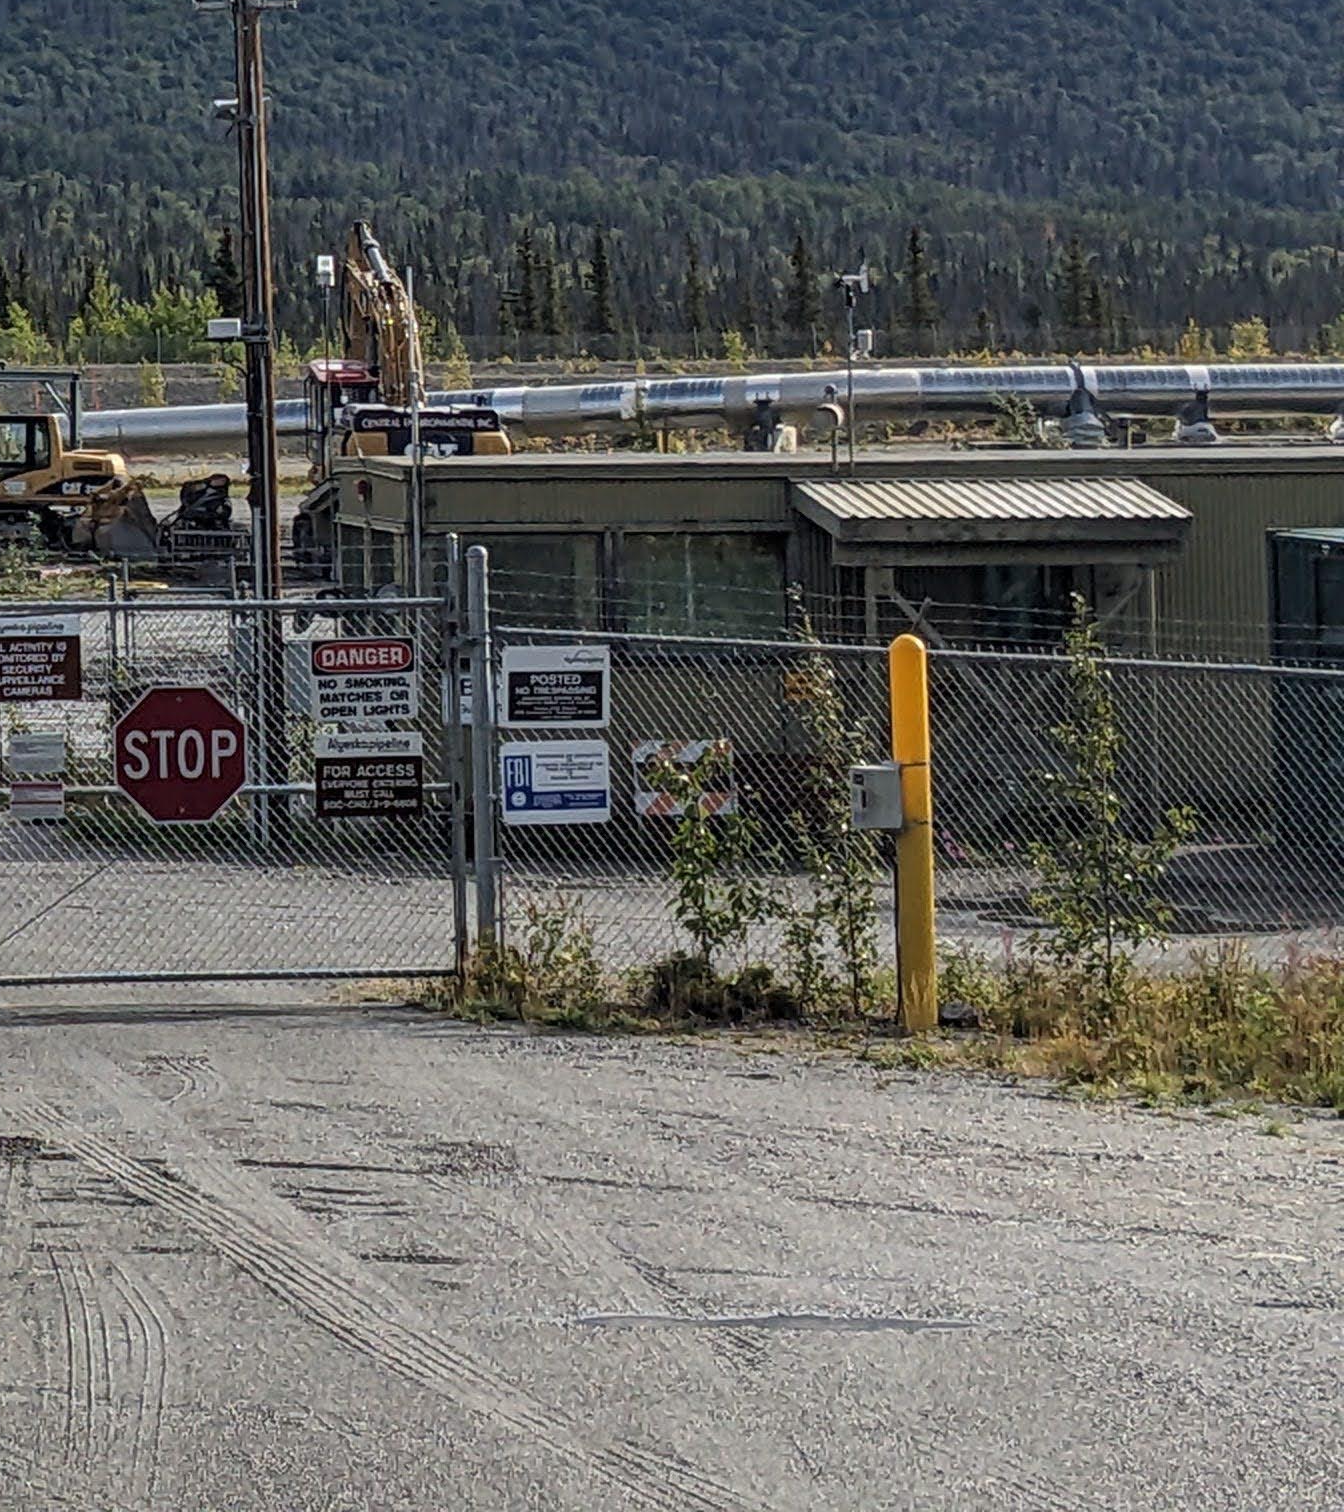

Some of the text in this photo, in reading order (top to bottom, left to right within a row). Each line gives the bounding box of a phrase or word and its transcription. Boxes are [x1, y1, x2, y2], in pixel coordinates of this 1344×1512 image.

[361, 418, 401, 428] CENTRAL
[403, 417, 474, 428] ENIRONMENTAL
[9, 642, 53, 652] ACTIVITY
[56, 641, 66, 651] IS
[52, 653, 66, 662] BY
[322, 648, 404, 666] DANGER
[1, 664, 52, 674] SECURITY
[318, 680, 337, 689] NO
[530, 674, 581, 685] POSTED
[3, 686, 53, 696] CAMERAS
[515, 686, 596, 694] NO TRESPASSING
[320, 691, 409, 703] MATCHES OR
[321, 704, 409, 717] OPEN LIGHTS
[123, 729, 237, 779] STOP
[323, 764, 415, 778] FOR ACCESS
[506, 758, 530, 787] FBI
[344, 790, 369, 798] MUST
